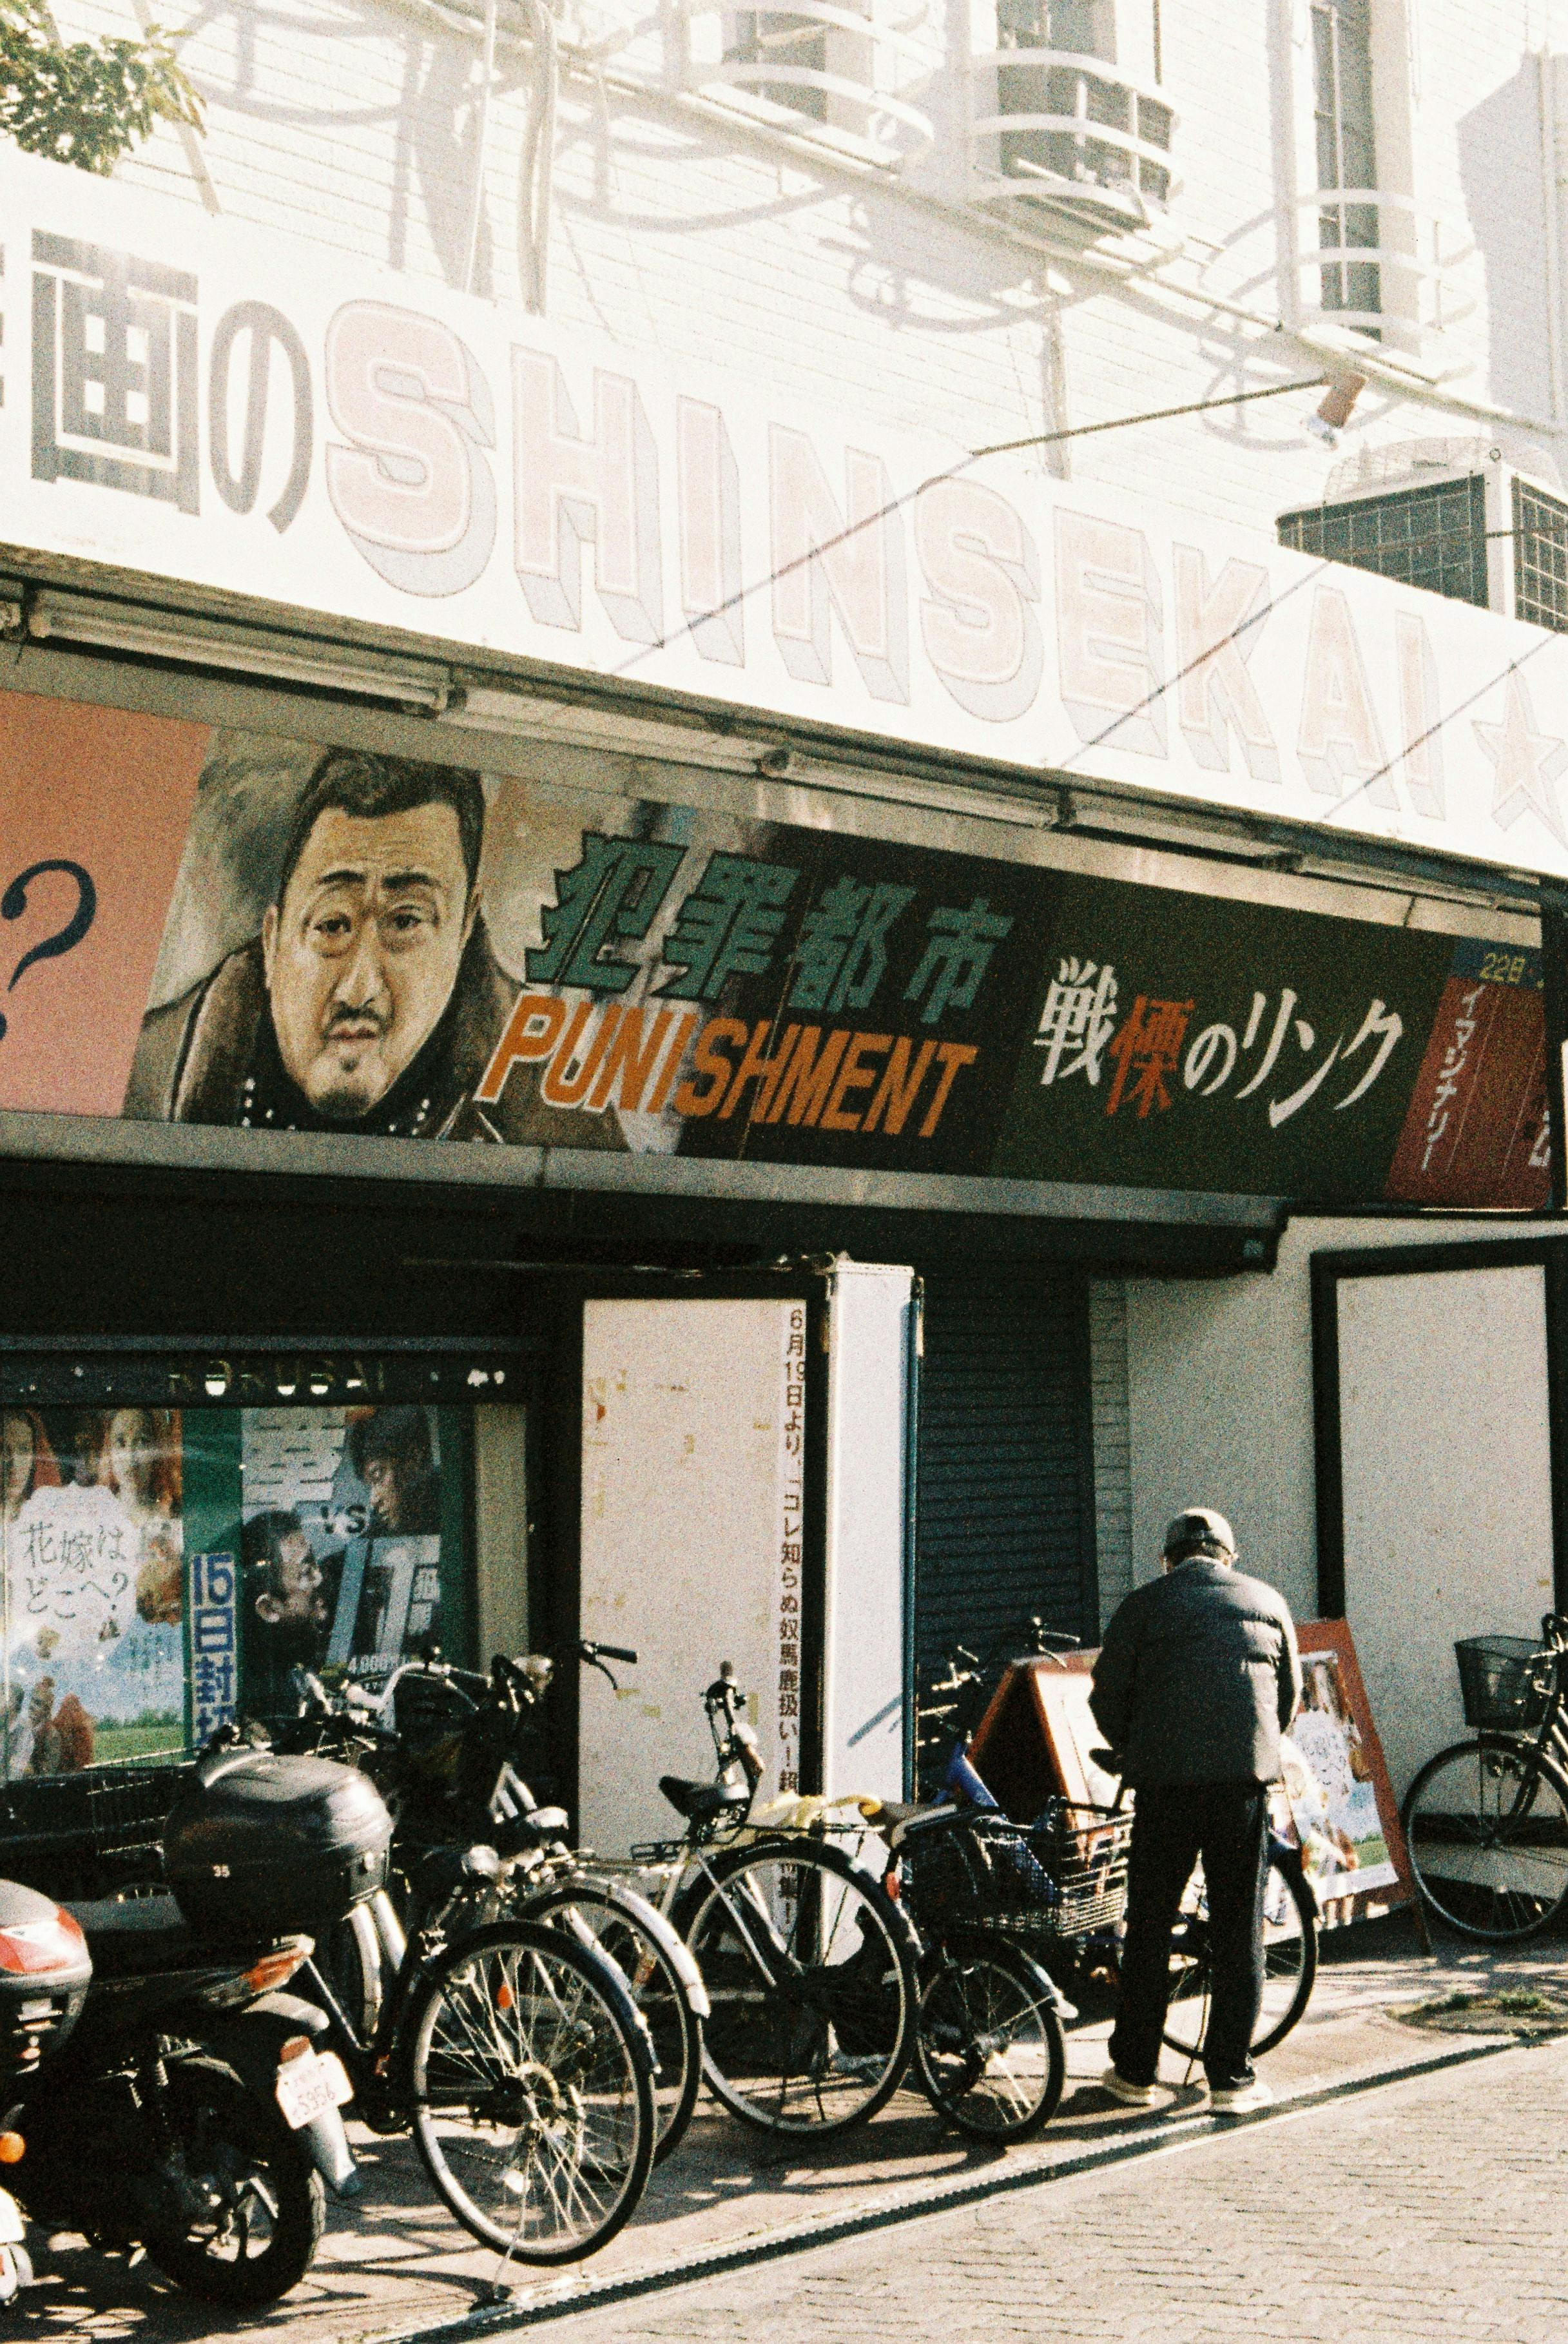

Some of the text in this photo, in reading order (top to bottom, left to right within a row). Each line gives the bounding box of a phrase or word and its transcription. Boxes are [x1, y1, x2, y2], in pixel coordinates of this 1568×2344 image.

[325, 300, 1446, 820] SHINSEKAI
[525, 831, 1015, 1023] 犯罪都市
[474, 991, 978, 1139] PUNISHMENT
